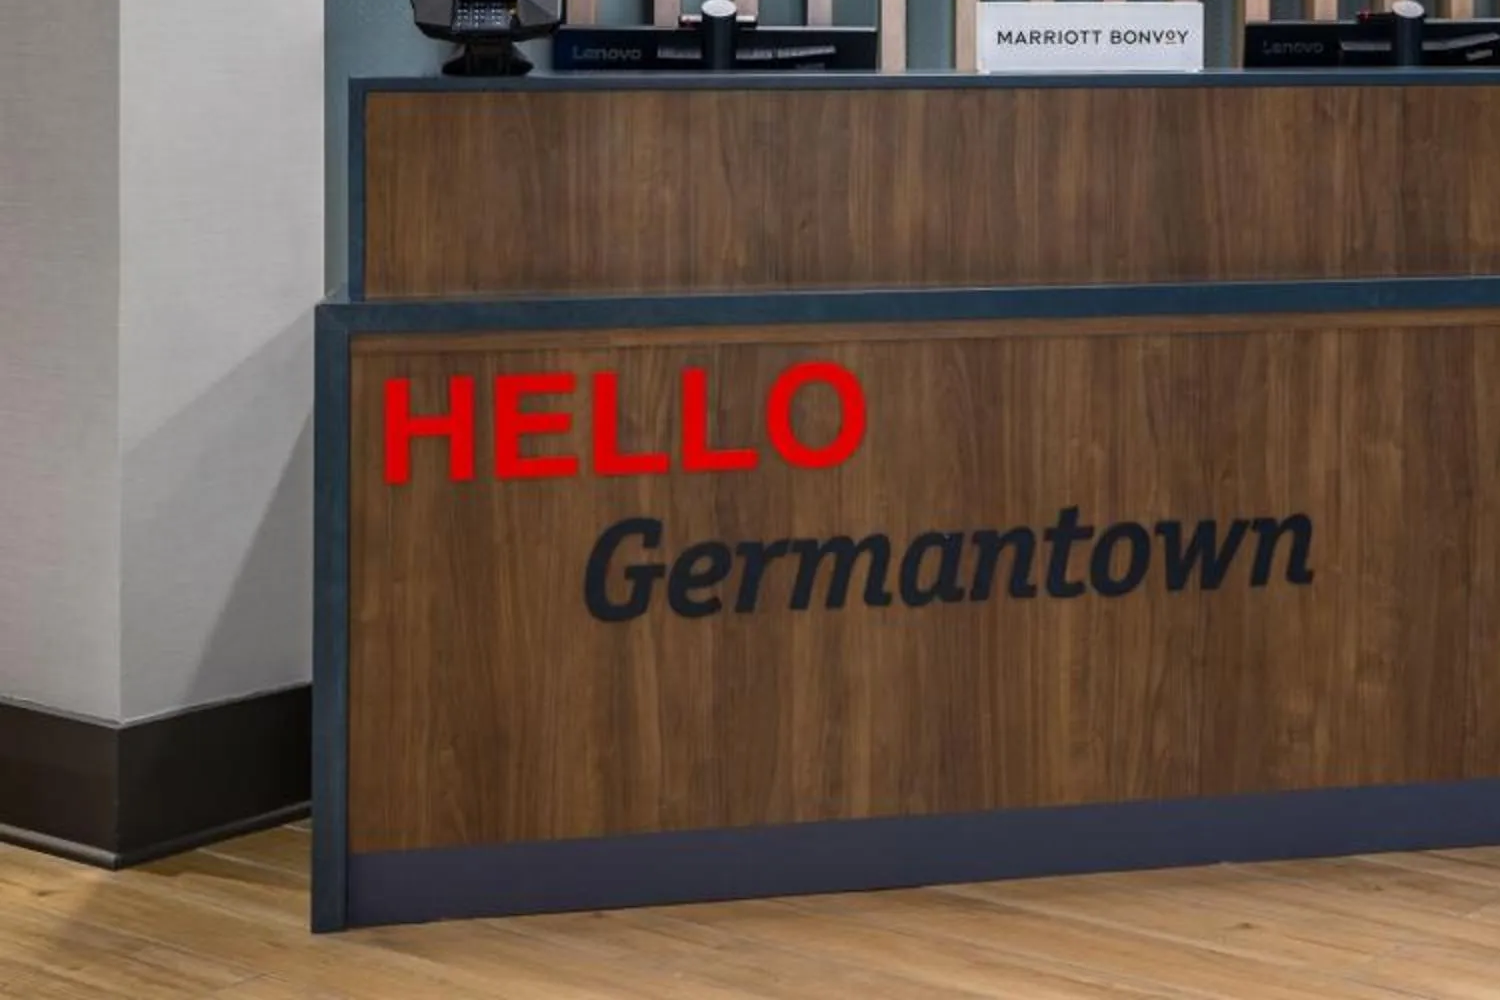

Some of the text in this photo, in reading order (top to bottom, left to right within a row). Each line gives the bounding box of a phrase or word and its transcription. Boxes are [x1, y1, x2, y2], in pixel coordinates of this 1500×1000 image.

[997, 30, 1102, 45] MARRIOTT
[572, 44, 642, 60] Lenovo
[1262, 39, 1325, 55] Lenovo
[382, 361, 867, 485] HELLO
[584, 506, 1315, 622] Germantown
